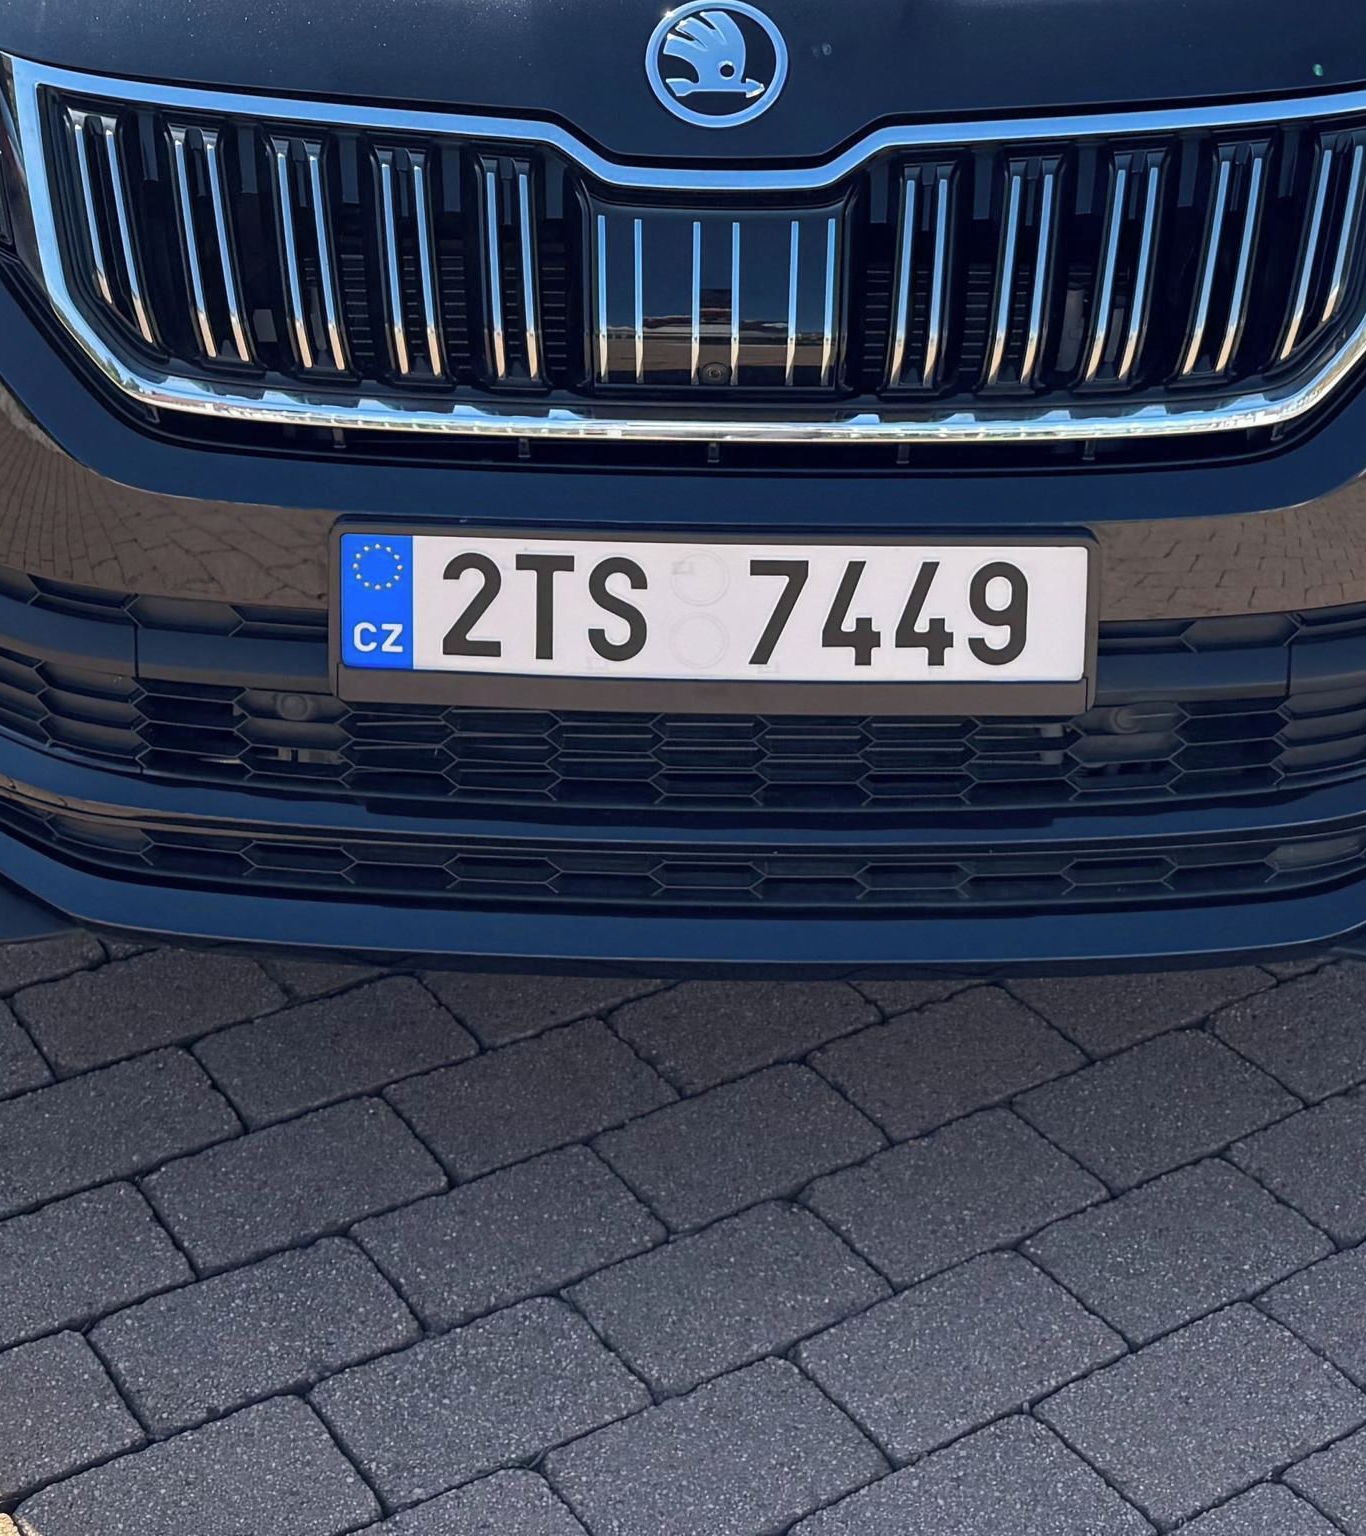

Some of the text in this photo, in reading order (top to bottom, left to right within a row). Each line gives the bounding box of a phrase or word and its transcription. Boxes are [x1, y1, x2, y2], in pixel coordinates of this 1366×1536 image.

[352, 622, 404, 654] CZ
[441, 552, 1029, 667] 2TS 7449
